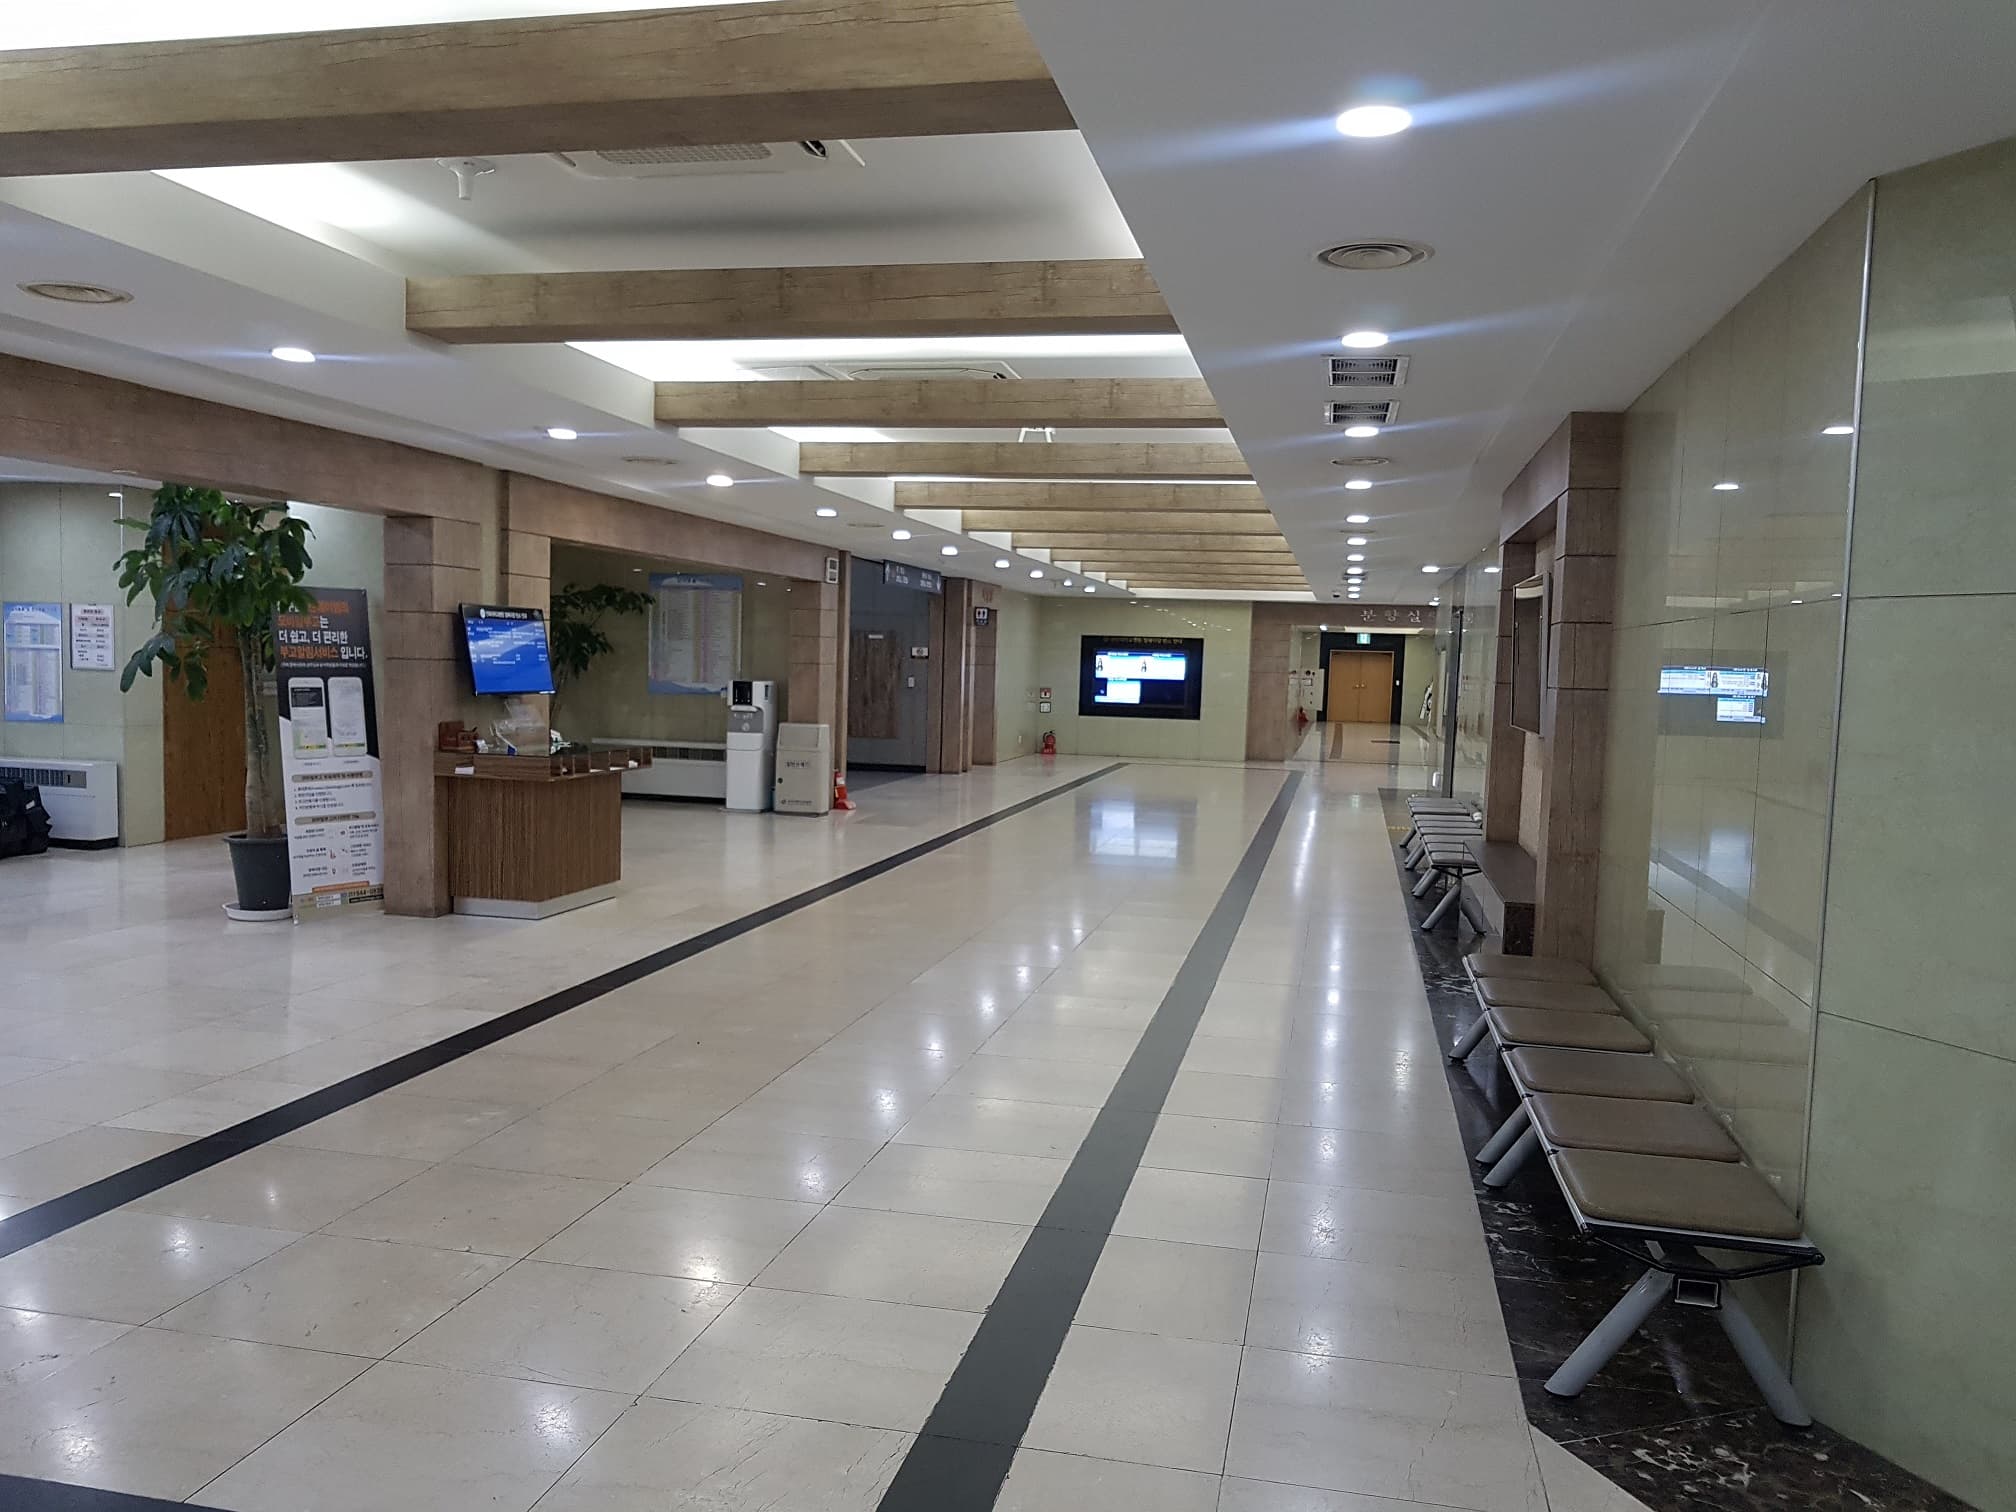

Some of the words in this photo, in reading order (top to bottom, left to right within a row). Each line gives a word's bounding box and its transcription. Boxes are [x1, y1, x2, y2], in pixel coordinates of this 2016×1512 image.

[279, 629, 288, 643] 더
[312, 630, 321, 643] 더
[323, 630, 348, 644] 편리한
[280, 645, 338, 659] 부고알림서비스
[340, 646, 368, 660] 입니다.
